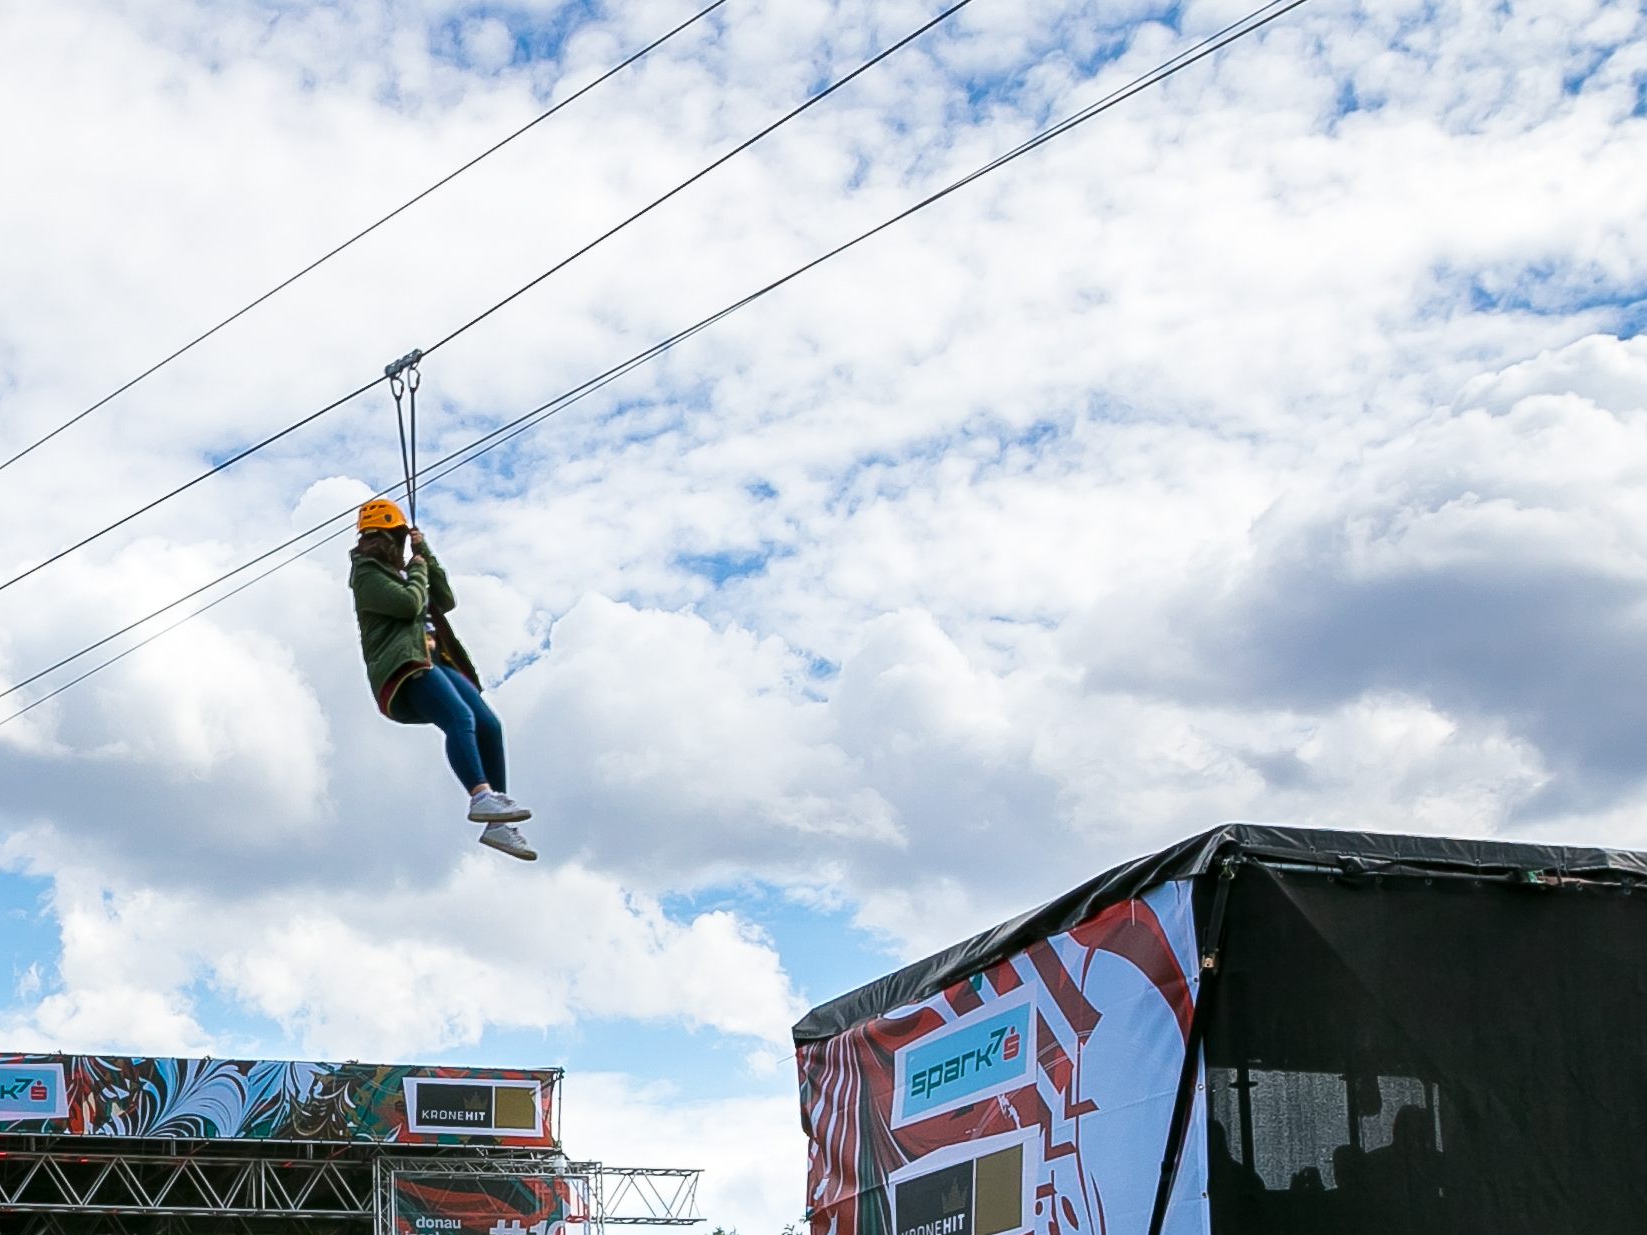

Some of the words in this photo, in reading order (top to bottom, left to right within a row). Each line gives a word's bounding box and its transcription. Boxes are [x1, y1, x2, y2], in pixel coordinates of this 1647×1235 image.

[911, 1026, 1009, 1099] spark7
[421, 1109, 486, 1121] KRONEHIT
[415, 1216, 462, 1230] donau
